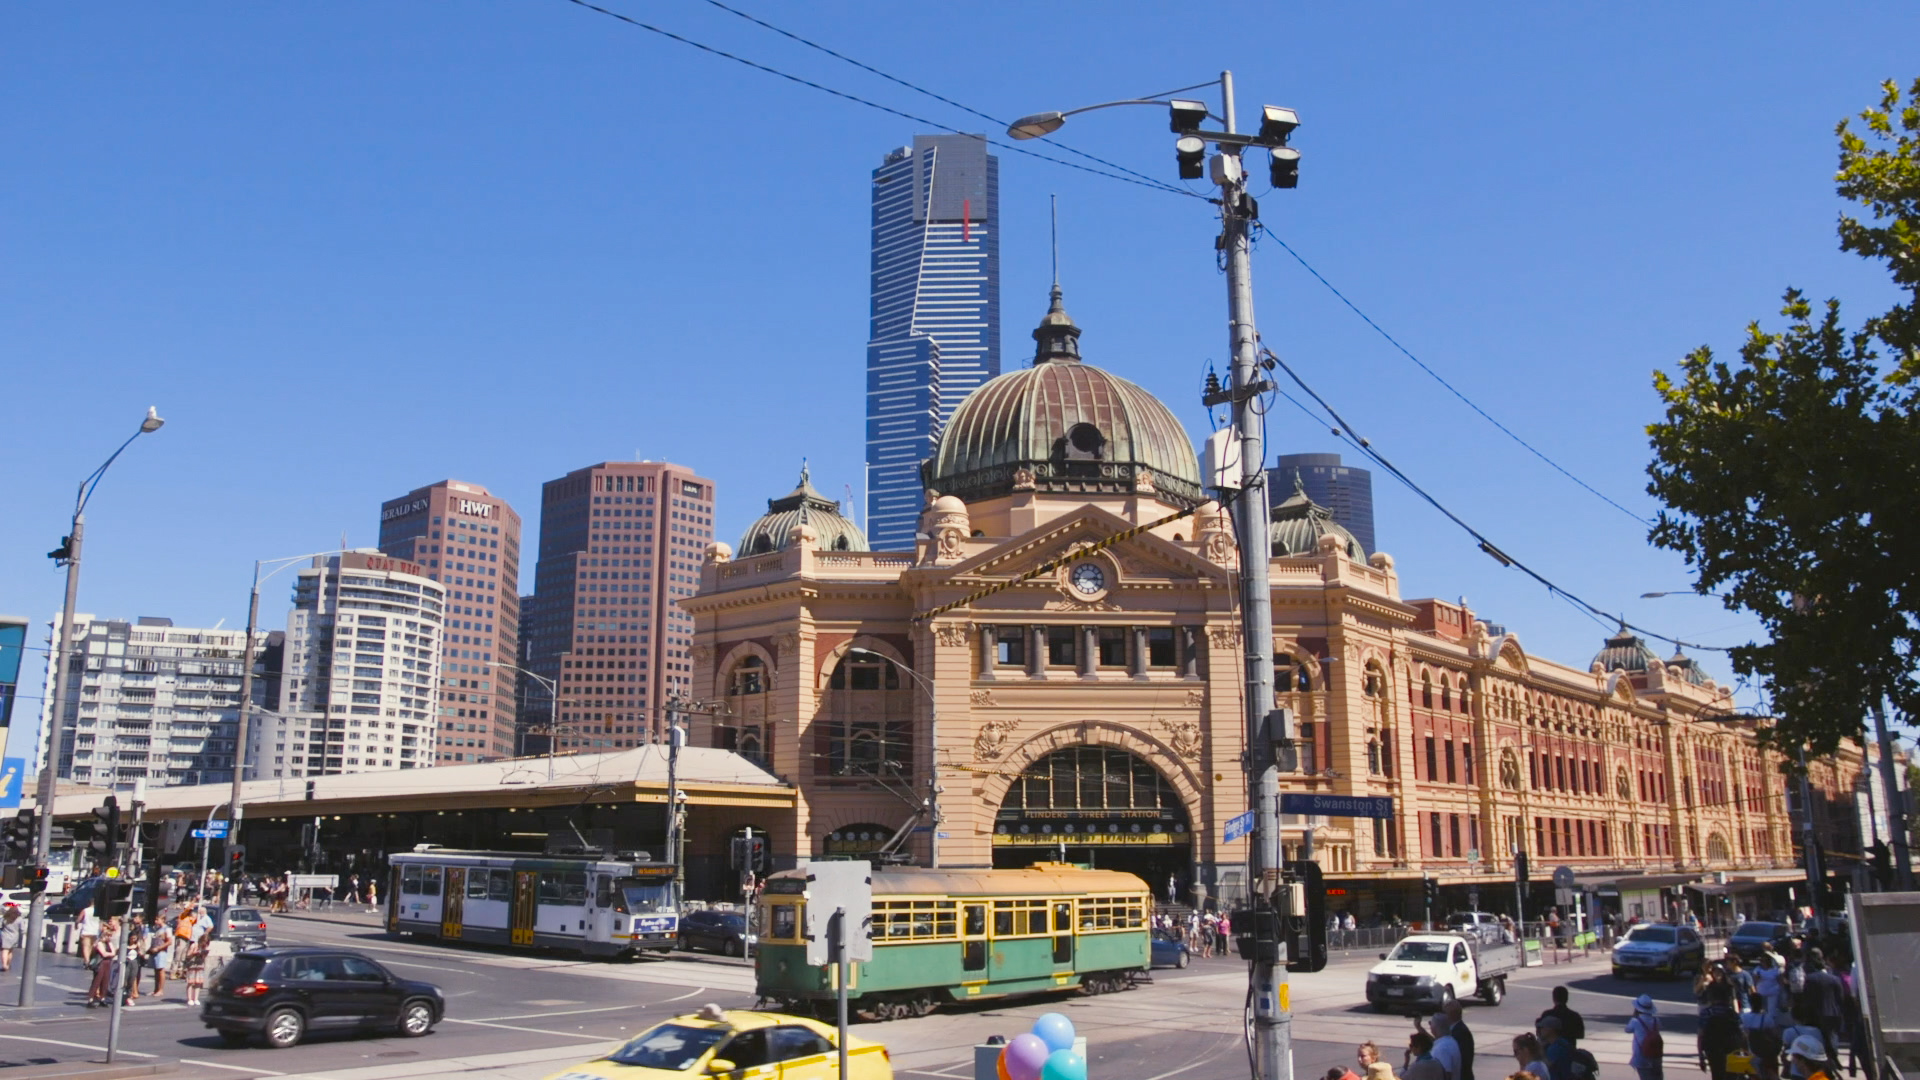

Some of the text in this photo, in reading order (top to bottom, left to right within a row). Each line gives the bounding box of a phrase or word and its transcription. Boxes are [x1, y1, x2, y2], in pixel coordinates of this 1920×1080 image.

[412, 498, 429, 512] SUN
[460, 500, 491, 516] HWT
[367, 557, 420, 576] QUAY WEST
[1313, 796, 1388, 810] Swanston St
[1025, 810, 1160, 819] FLINDERS STREET STATION
